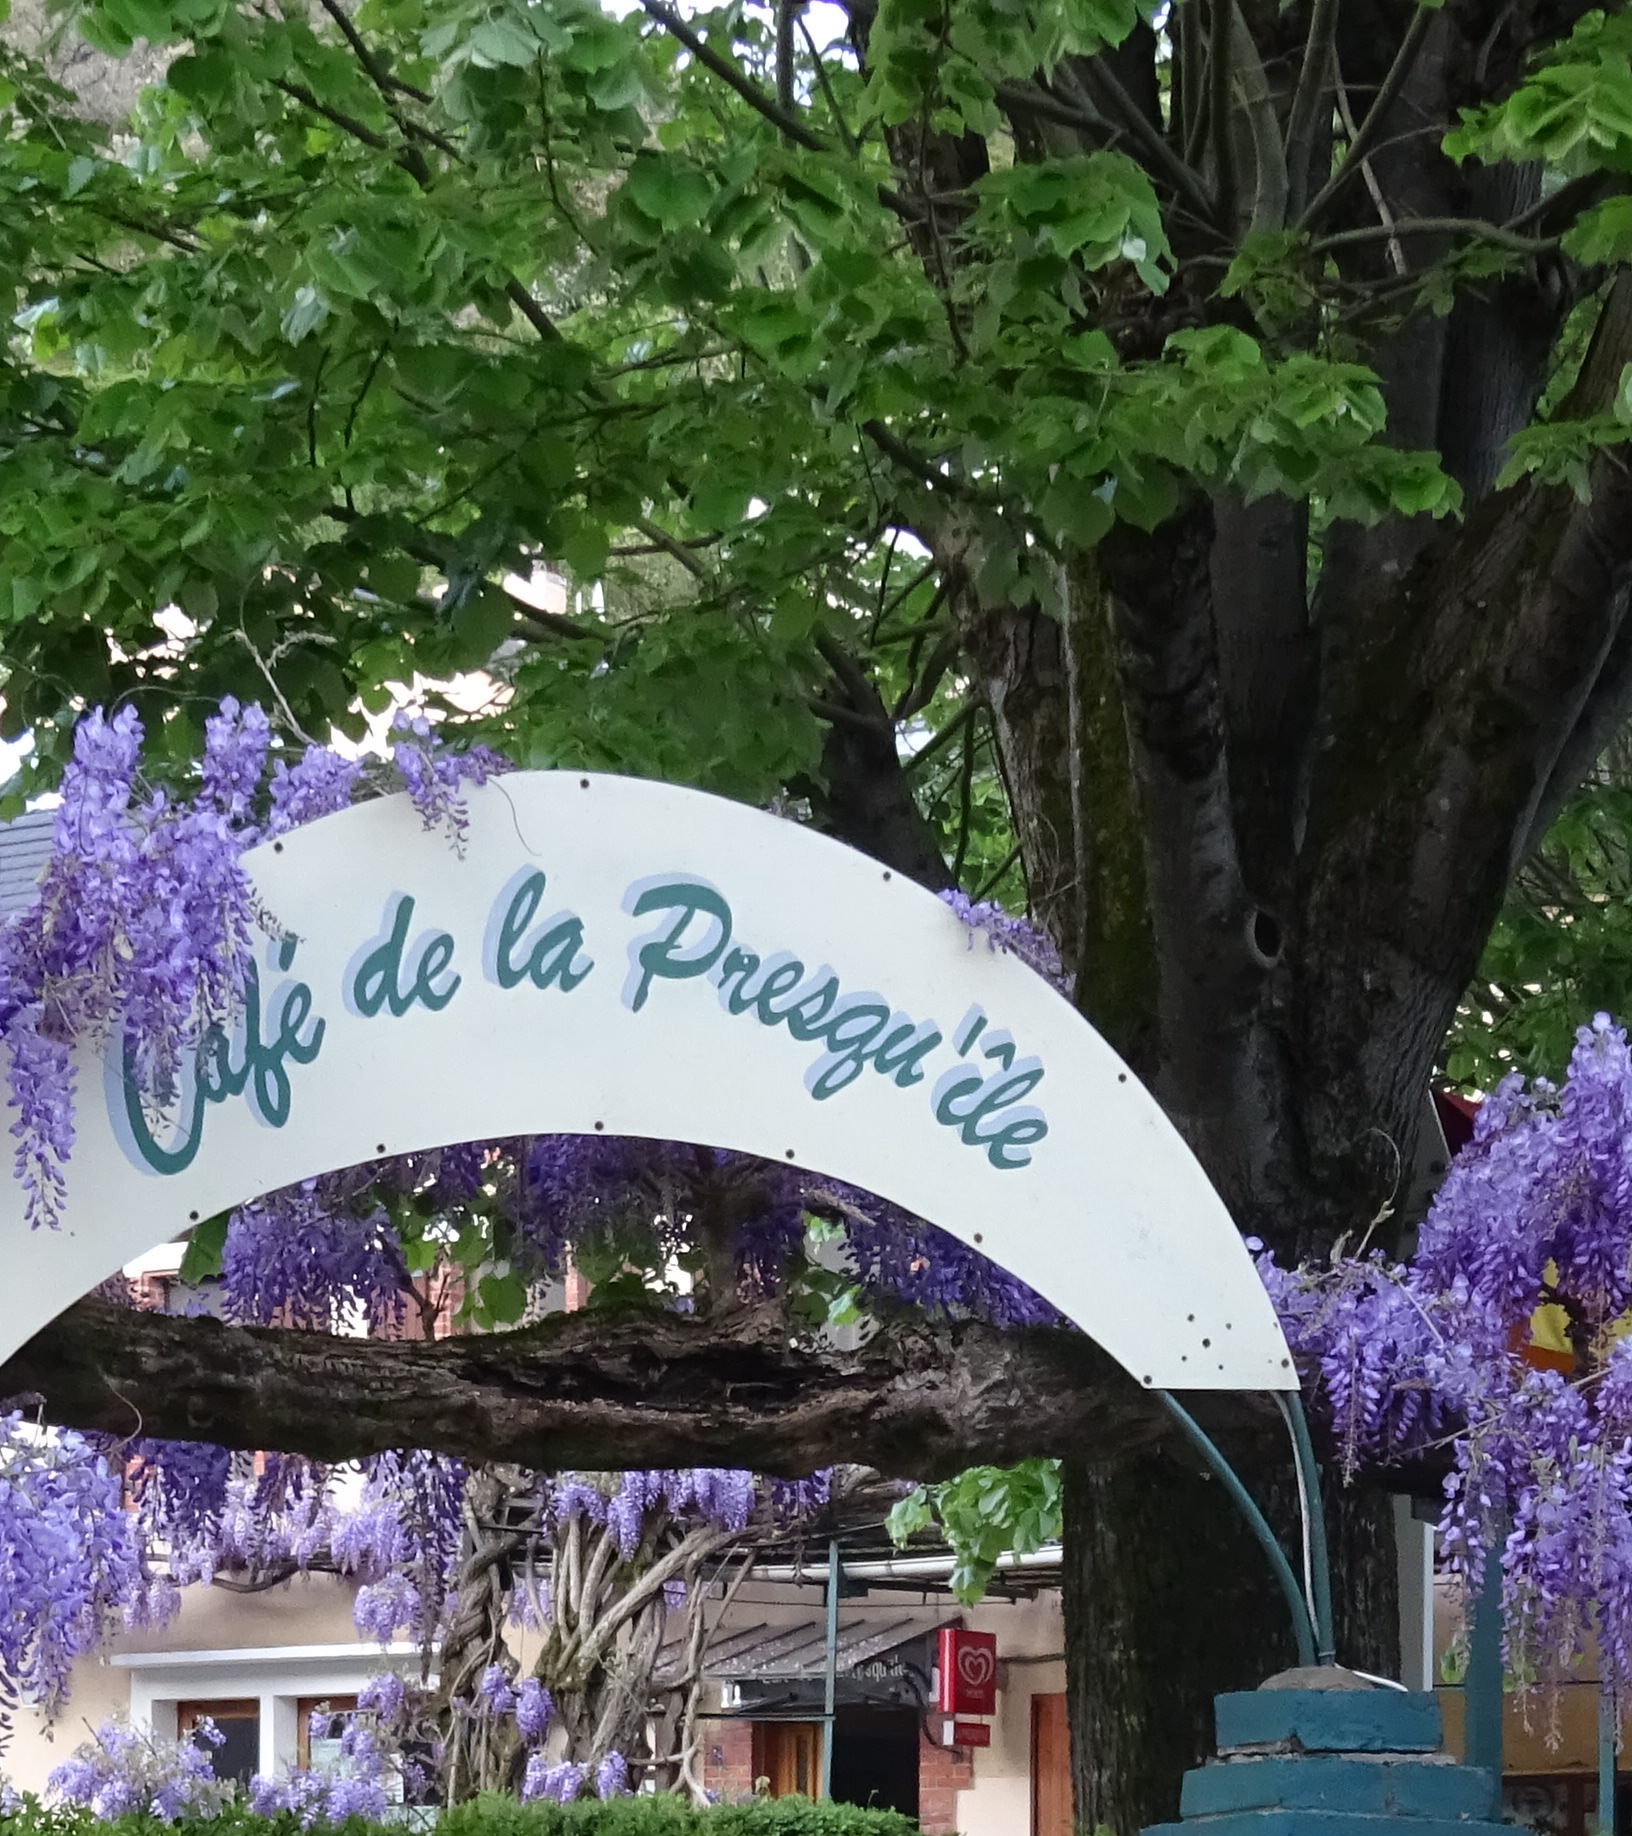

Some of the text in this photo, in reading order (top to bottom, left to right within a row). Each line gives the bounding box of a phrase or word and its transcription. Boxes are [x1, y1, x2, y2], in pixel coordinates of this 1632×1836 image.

[106, 866, 1046, 1175] Café de la Presqu'île
